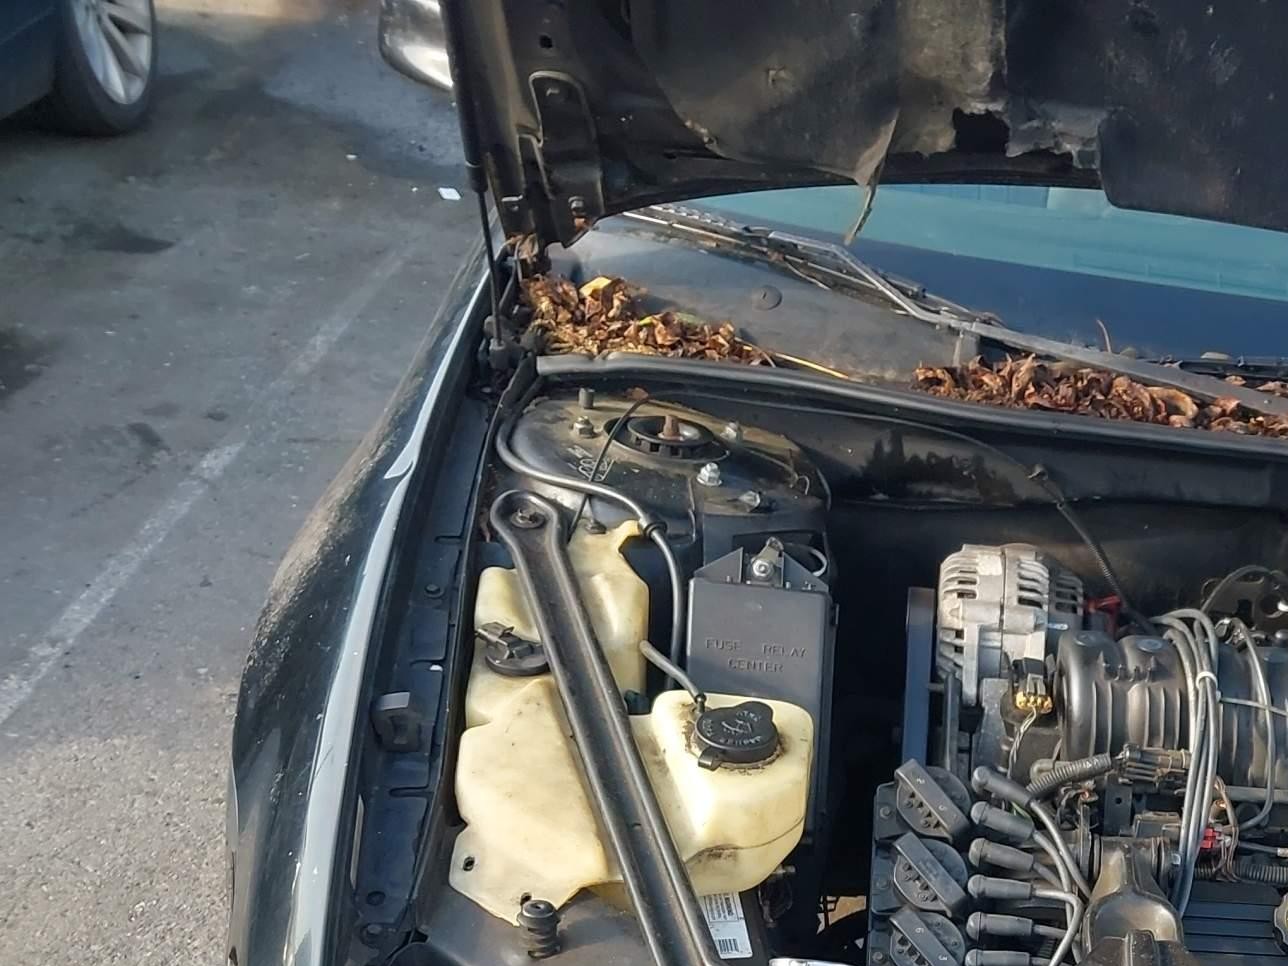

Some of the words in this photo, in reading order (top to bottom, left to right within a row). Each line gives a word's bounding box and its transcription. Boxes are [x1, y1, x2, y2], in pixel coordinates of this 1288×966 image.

[705, 637, 742, 651] FUSE
[762, 643, 807, 657] RELAY
[727, 658, 784, 672] CENTER
